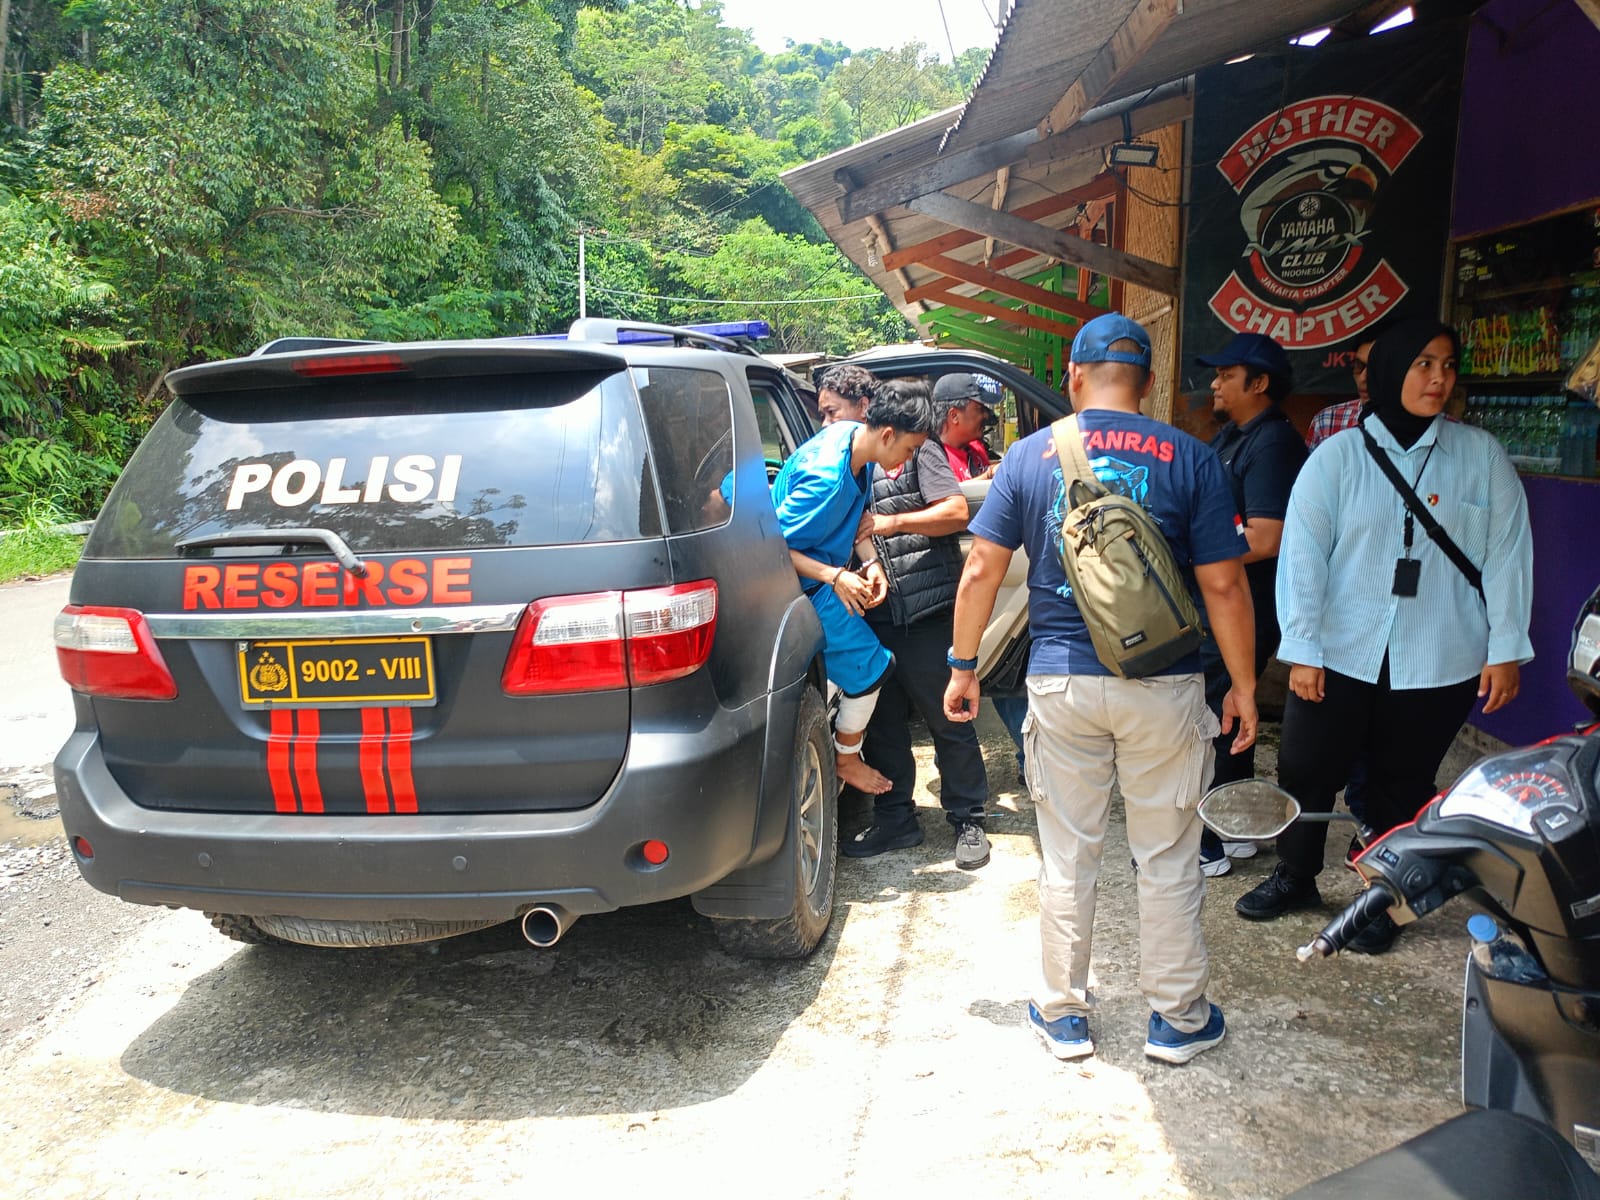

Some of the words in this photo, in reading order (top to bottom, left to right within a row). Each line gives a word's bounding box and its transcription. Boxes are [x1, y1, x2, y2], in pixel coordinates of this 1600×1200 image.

[1238, 105, 1397, 167] MOTHER
[1280, 217, 1336, 239] YAMAHA
[1280, 251, 1327, 269] CLUB
[1281, 266, 1326, 279] INDONESIA
[1260, 275, 1300, 299] JAKARTA
[1302, 267, 1349, 299] CHAPTER
[1229, 283, 1390, 342] CHAPTER
[1042, 430, 1175, 463] JTANRAS
[225, 454, 462, 511] POLISI
[183, 557, 472, 610] RESERSE
[301, 658, 360, 683] 9002
[380, 656, 422, 681] VIII
